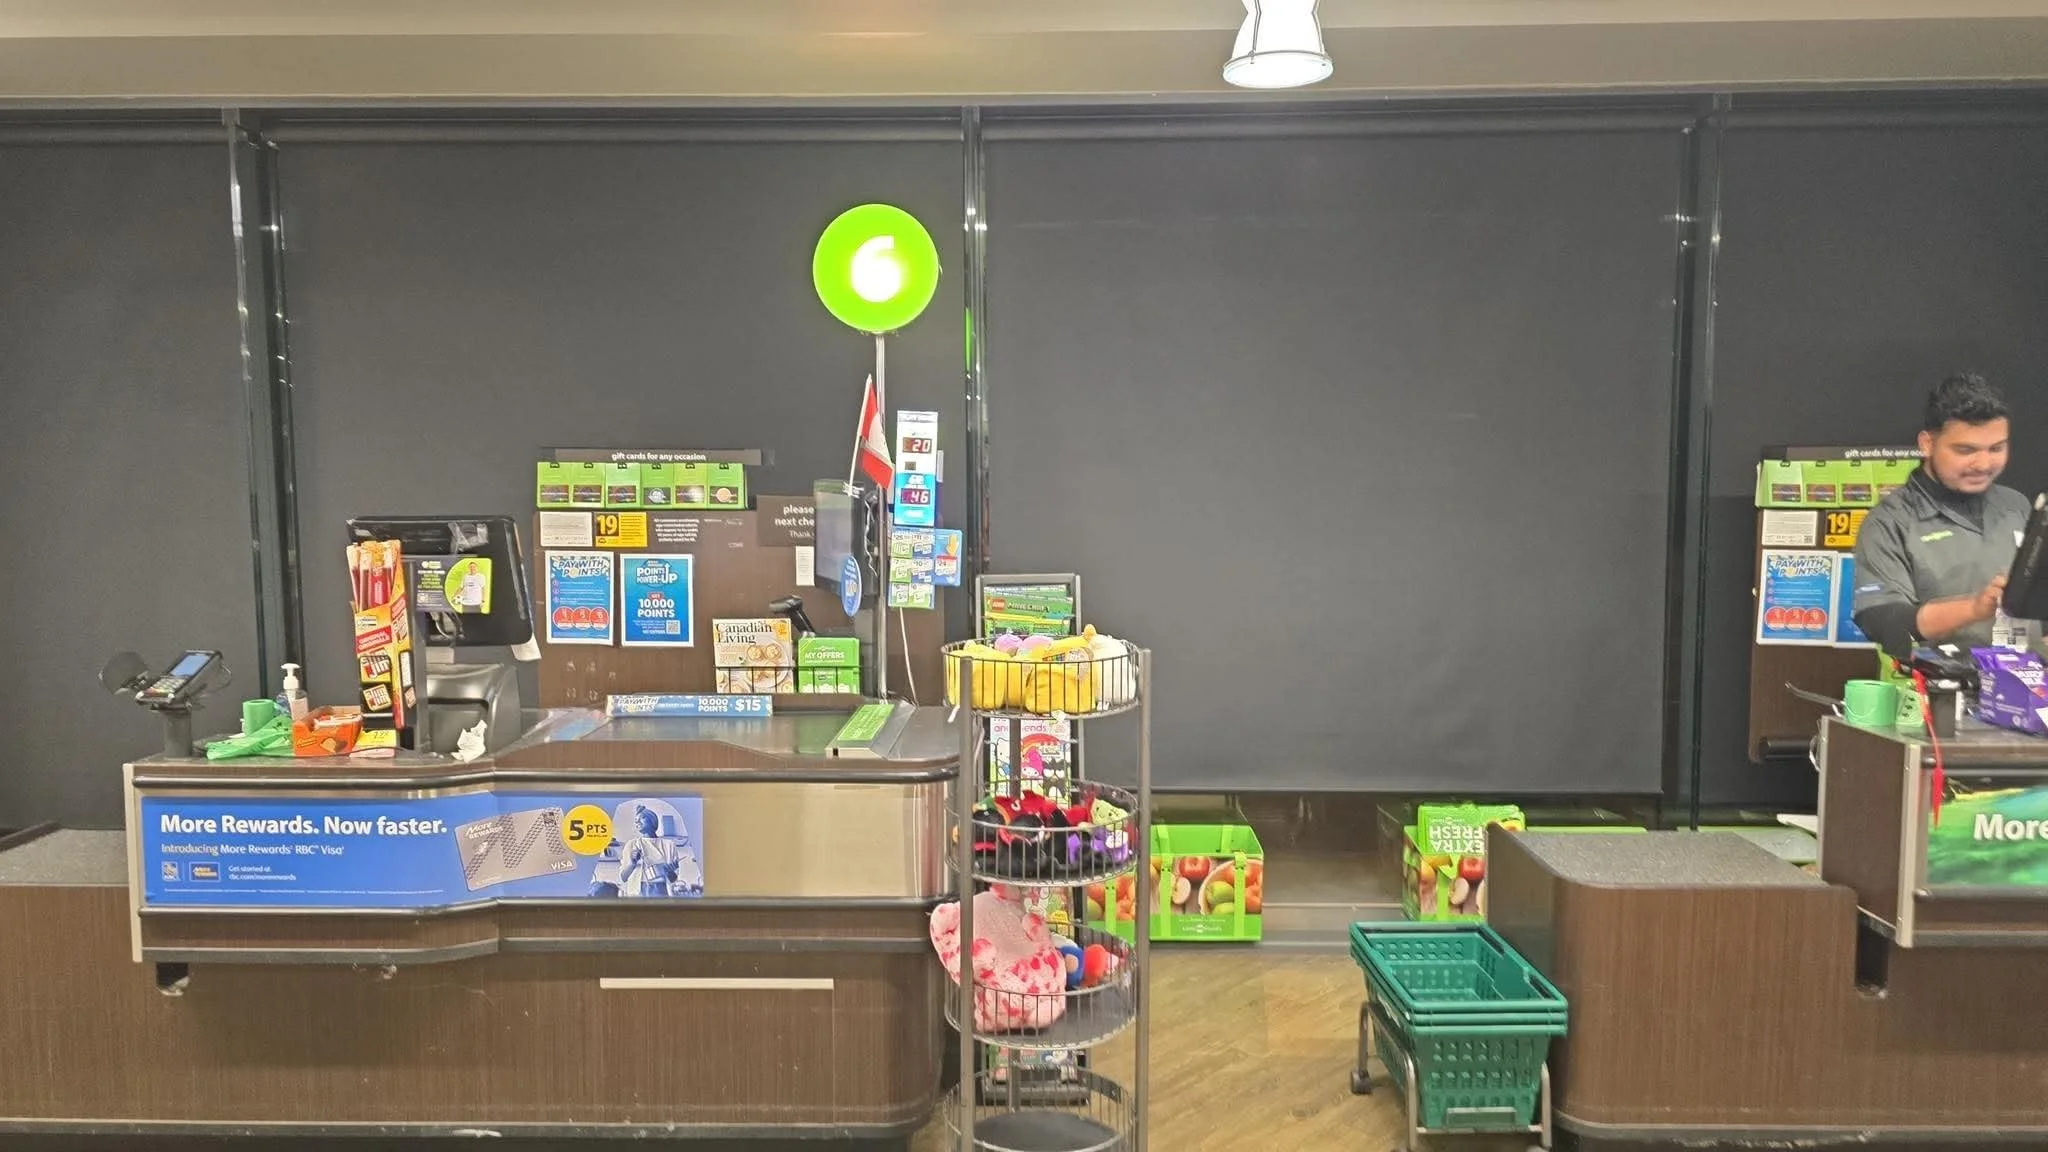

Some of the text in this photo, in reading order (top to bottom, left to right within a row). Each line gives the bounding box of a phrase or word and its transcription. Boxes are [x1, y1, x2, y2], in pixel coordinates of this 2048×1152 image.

[850, 234, 901, 303] 6
[912, 439, 931, 452] 20
[612, 452, 707, 462] gift cards for any occasion
[1844, 449, 1859, 459] gift
[1860, 449, 1881, 457] cards
[1882, 448, 1893, 457] for
[1895, 450, 1910, 459] any
[911, 491, 929, 503] 46
[783, 503, 815, 516] please
[596, 515, 618, 535] 19
[774, 517, 797, 527] next
[1827, 513, 1849, 534] 19
[788, 529, 811, 538] Thank
[559, 559, 604, 569] PAY WITH
[1776, 558, 1824, 568] PAY WITH
[563, 568, 601, 578] POINTS
[636, 567, 666, 577] POINTS
[636, 571, 678, 584] POWER-UP
[638, 599, 675, 609] 10,000
[637, 609, 675, 618] POINTS
[716, 622, 773, 633] Canadian
[718, 632, 757, 645] Living
[817, 651, 845, 659] OFFERS
[698, 698, 729, 706] 10,000
[735, 698, 761, 713] $15
[698, 705, 728, 713] POINTS
[161, 814, 447, 836] More Rewards. Now faster.
[466, 822, 493, 836] More
[569, 819, 584, 841] 5
[587, 824, 607, 834] PTS
[1429, 825, 1484, 839] FRESH
[161, 843, 219, 856] Introducing
[220, 844, 246, 854] More
[1430, 839, 1485, 854] EXTRA
[551, 860, 573, 870] VISA
